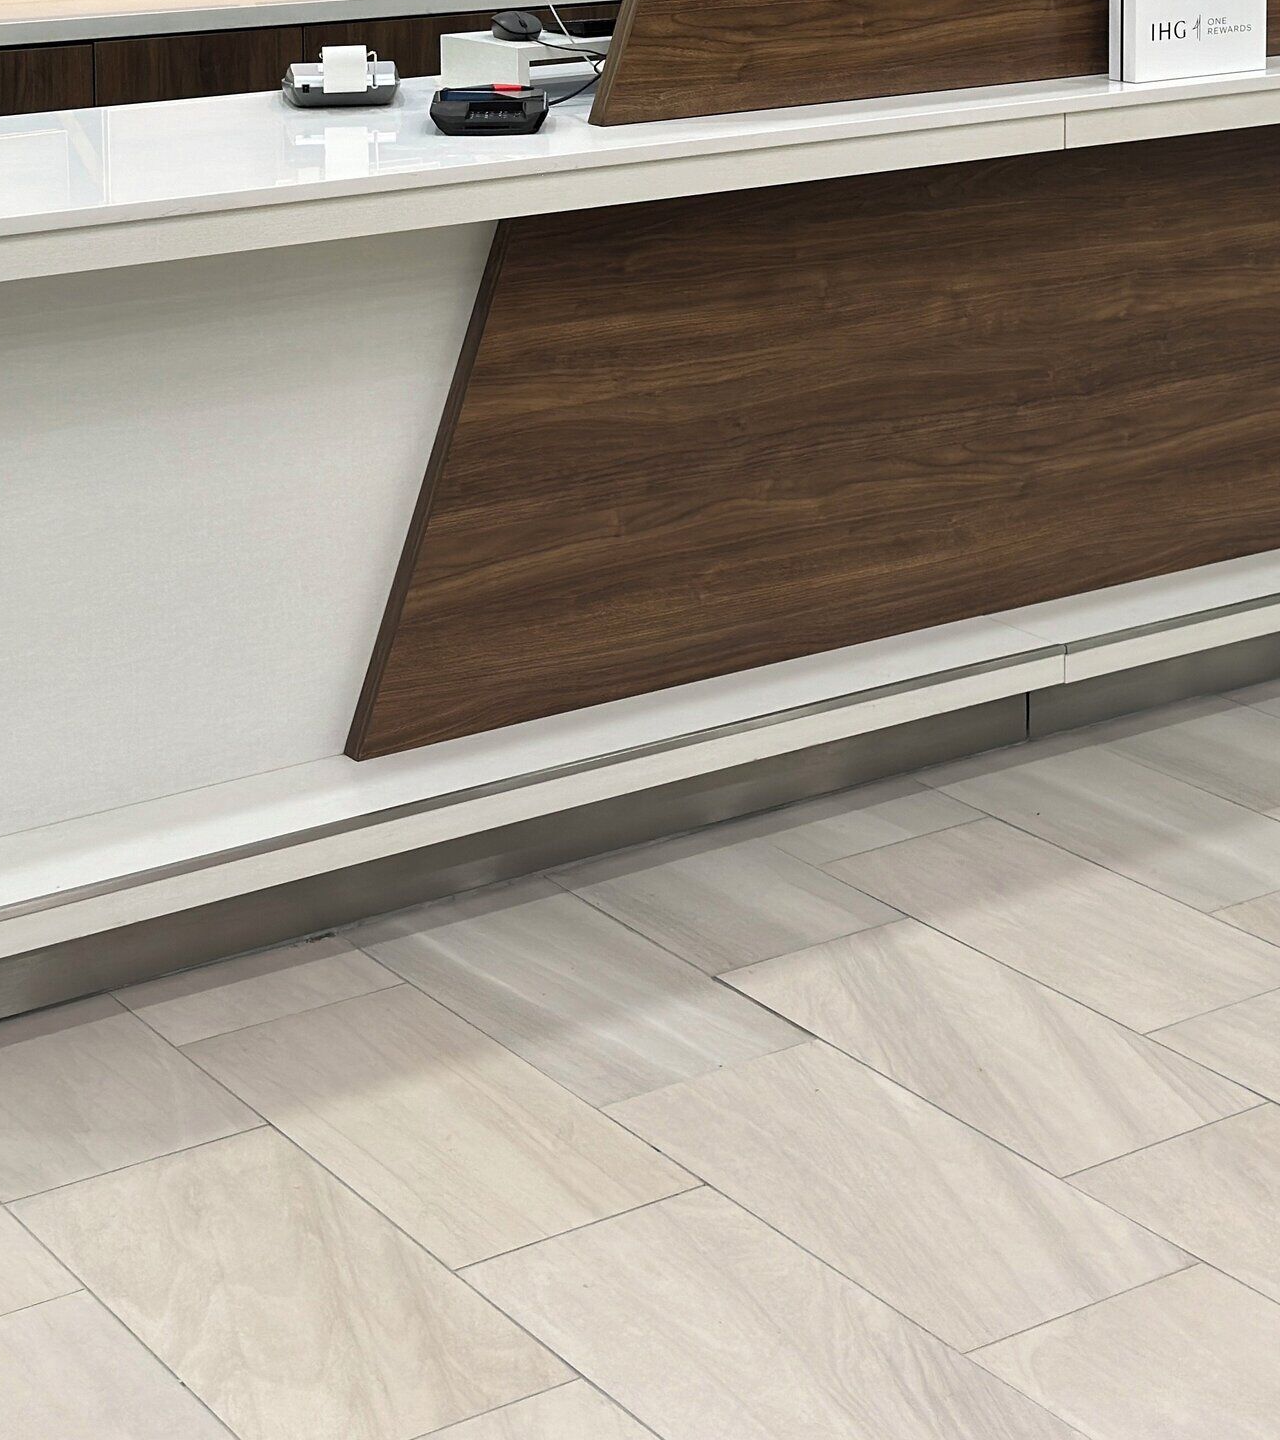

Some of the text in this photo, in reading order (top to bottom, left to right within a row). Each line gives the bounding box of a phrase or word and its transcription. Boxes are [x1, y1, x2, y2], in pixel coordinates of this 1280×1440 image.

[1151, 16, 1227, 41] IHG ONE
[1207, 23, 1252, 35] REWARDS
